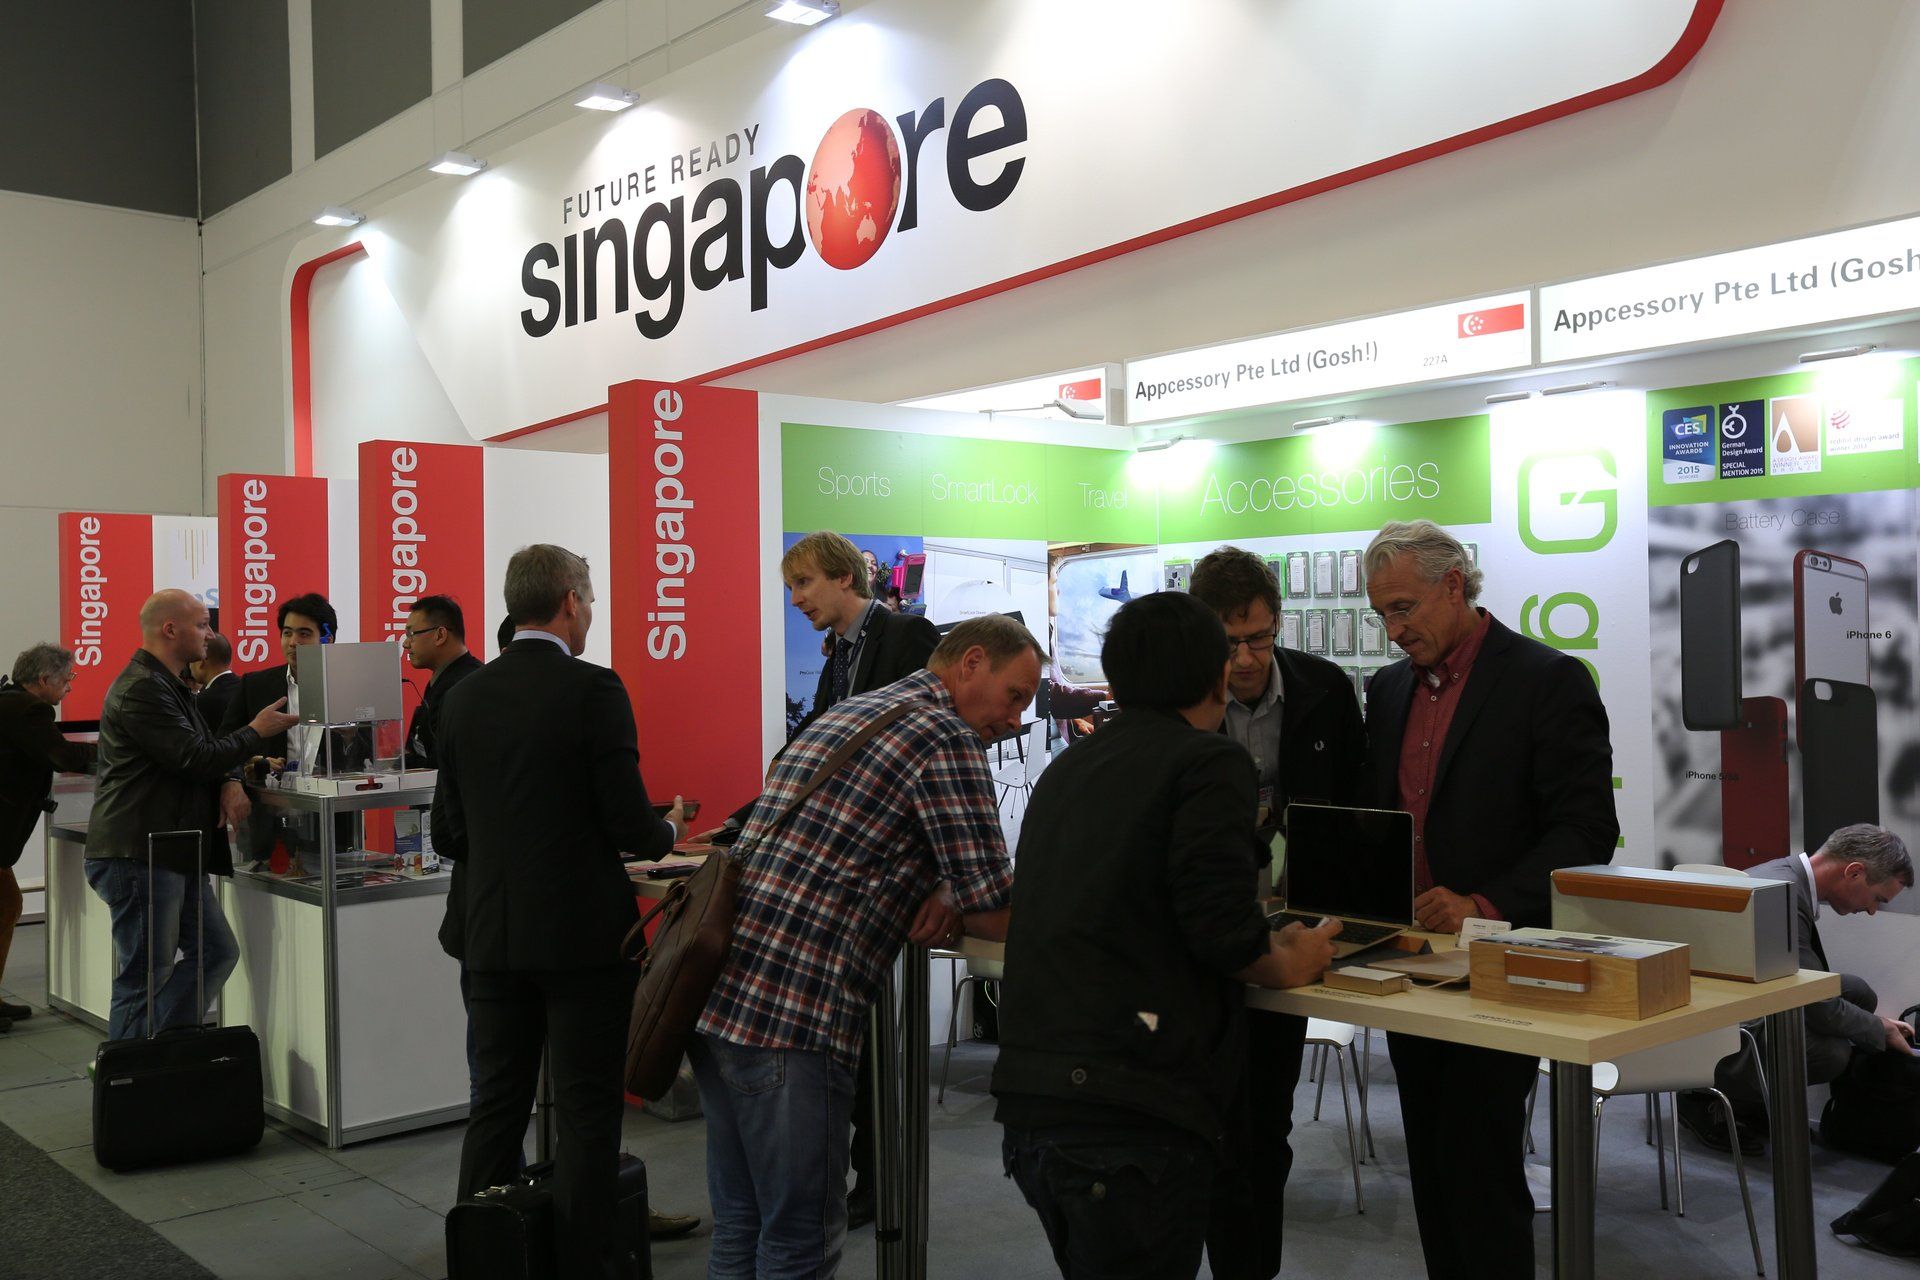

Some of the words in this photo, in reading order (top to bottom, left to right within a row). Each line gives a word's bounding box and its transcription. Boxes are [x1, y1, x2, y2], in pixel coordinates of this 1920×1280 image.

[563, 164, 656, 225] FUTURE
[671, 123, 760, 185] READY
[520, 77, 1028, 340] singapore
[1553, 291, 1705, 334] Appcessory
[1713, 280, 1760, 305] Pte
[1770, 265, 1819, 296] Ltd
[1135, 368, 1230, 402] Appcessory
[1235, 362, 1265, 383] Pte
[1270, 353, 1301, 377] Ltd
[1306, 340, 1378, 373] (Gosh!)
[1422, 353, 1448, 368] 227A
[1674, 421, 1701, 436] CES
[1668, 441, 1710, 451] INNOVATION
[1675, 447, 1703, 456] AWARDS
[1721, 441, 1746, 449] German
[1721, 448, 1742, 457] Design
[1743, 446, 1764, 455] Award
[1677, 465, 1700, 475] 2015
[1722, 461, 1746, 469] SPECIAL
[1722, 468, 1750, 477] MENTION
[1750, 467, 1764, 475] 2015
[817, 466, 892, 501] Sports
[930, 472, 1040, 506] SmartLock
[1077, 481, 1129, 510] Travel
[1199, 454, 1440, 518] Accessories
[647, 388, 696, 661] Singapore
[1725, 512, 1786, 532] Battery
[1790, 507, 1841, 527] Case
[237, 478, 277, 663] Singapore
[74, 516, 109, 667] Singapore
[1846, 630, 1883, 640] iPhone
[1885, 630, 1892, 639] 6
[1685, 770, 1717, 780] iPhone
